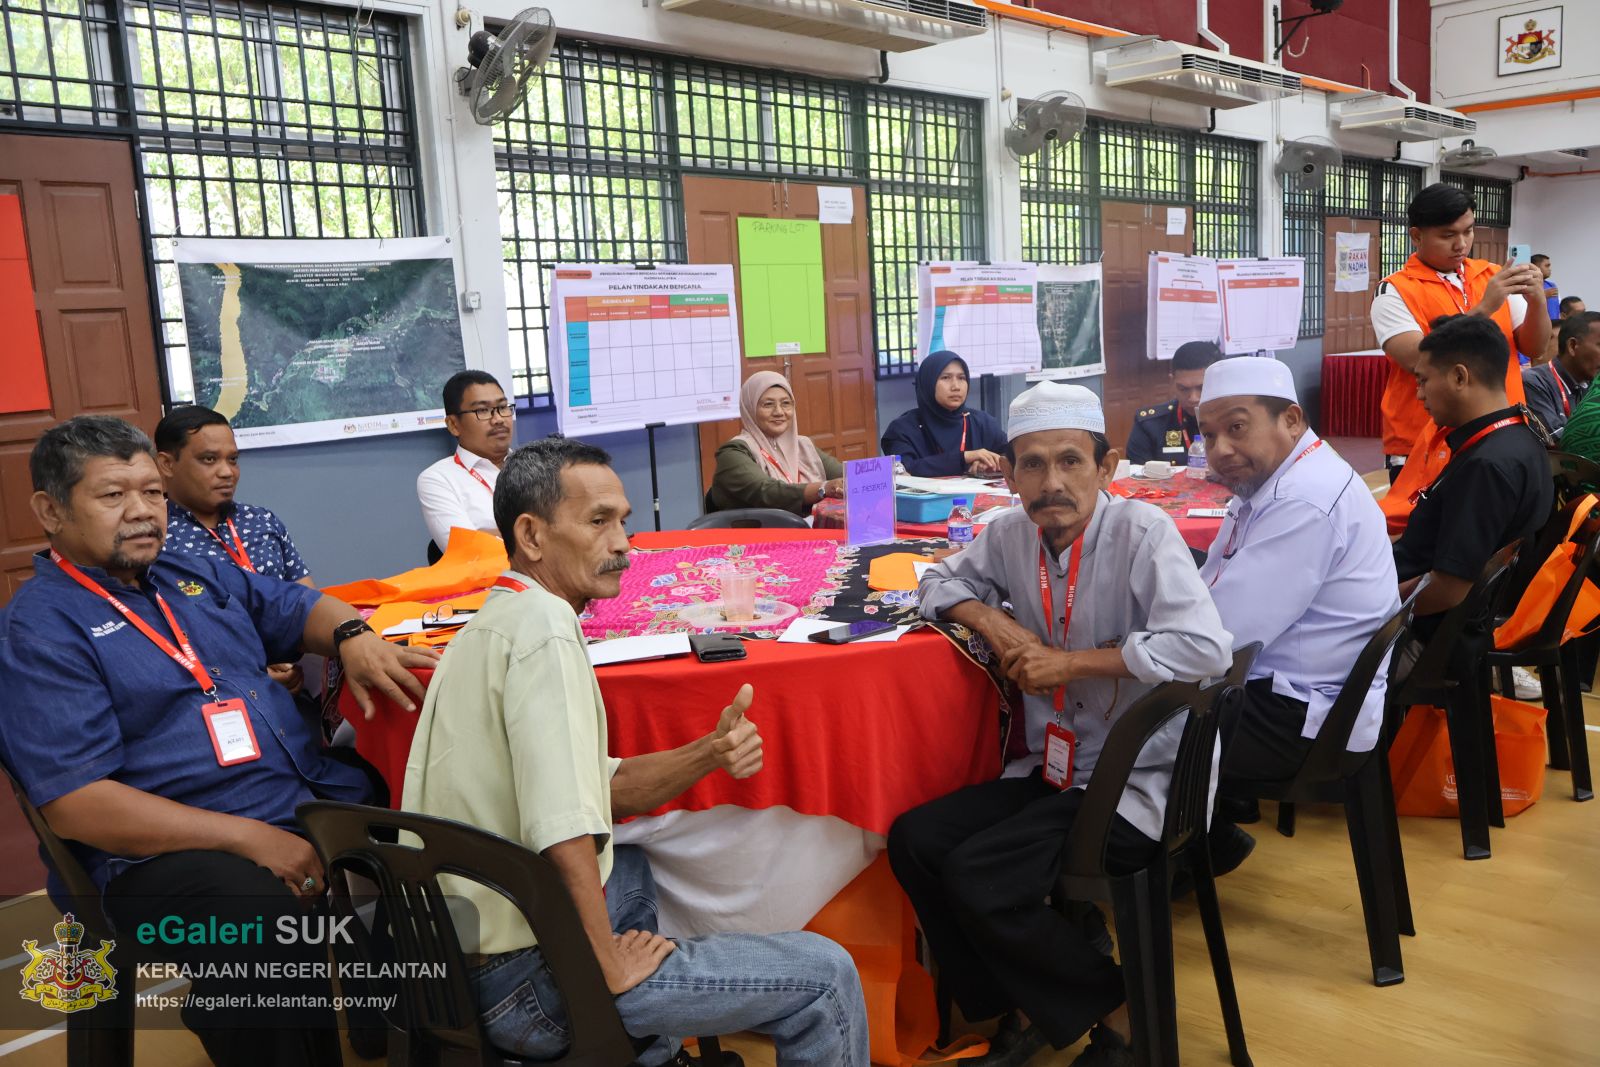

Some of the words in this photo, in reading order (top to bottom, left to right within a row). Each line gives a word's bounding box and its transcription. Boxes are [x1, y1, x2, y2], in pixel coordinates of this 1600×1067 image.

[752, 221, 788, 234] PARKING
[789, 222, 808, 234] LOT
[855, 459, 882, 475] DELTA
[862, 482, 887, 493] PESERTA
[1039, 566, 1049, 590] NADIM
[1067, 585, 1076, 607] NADIM
[172, 652, 195, 670] NADIM
[181, 643, 197, 662] NADIM
